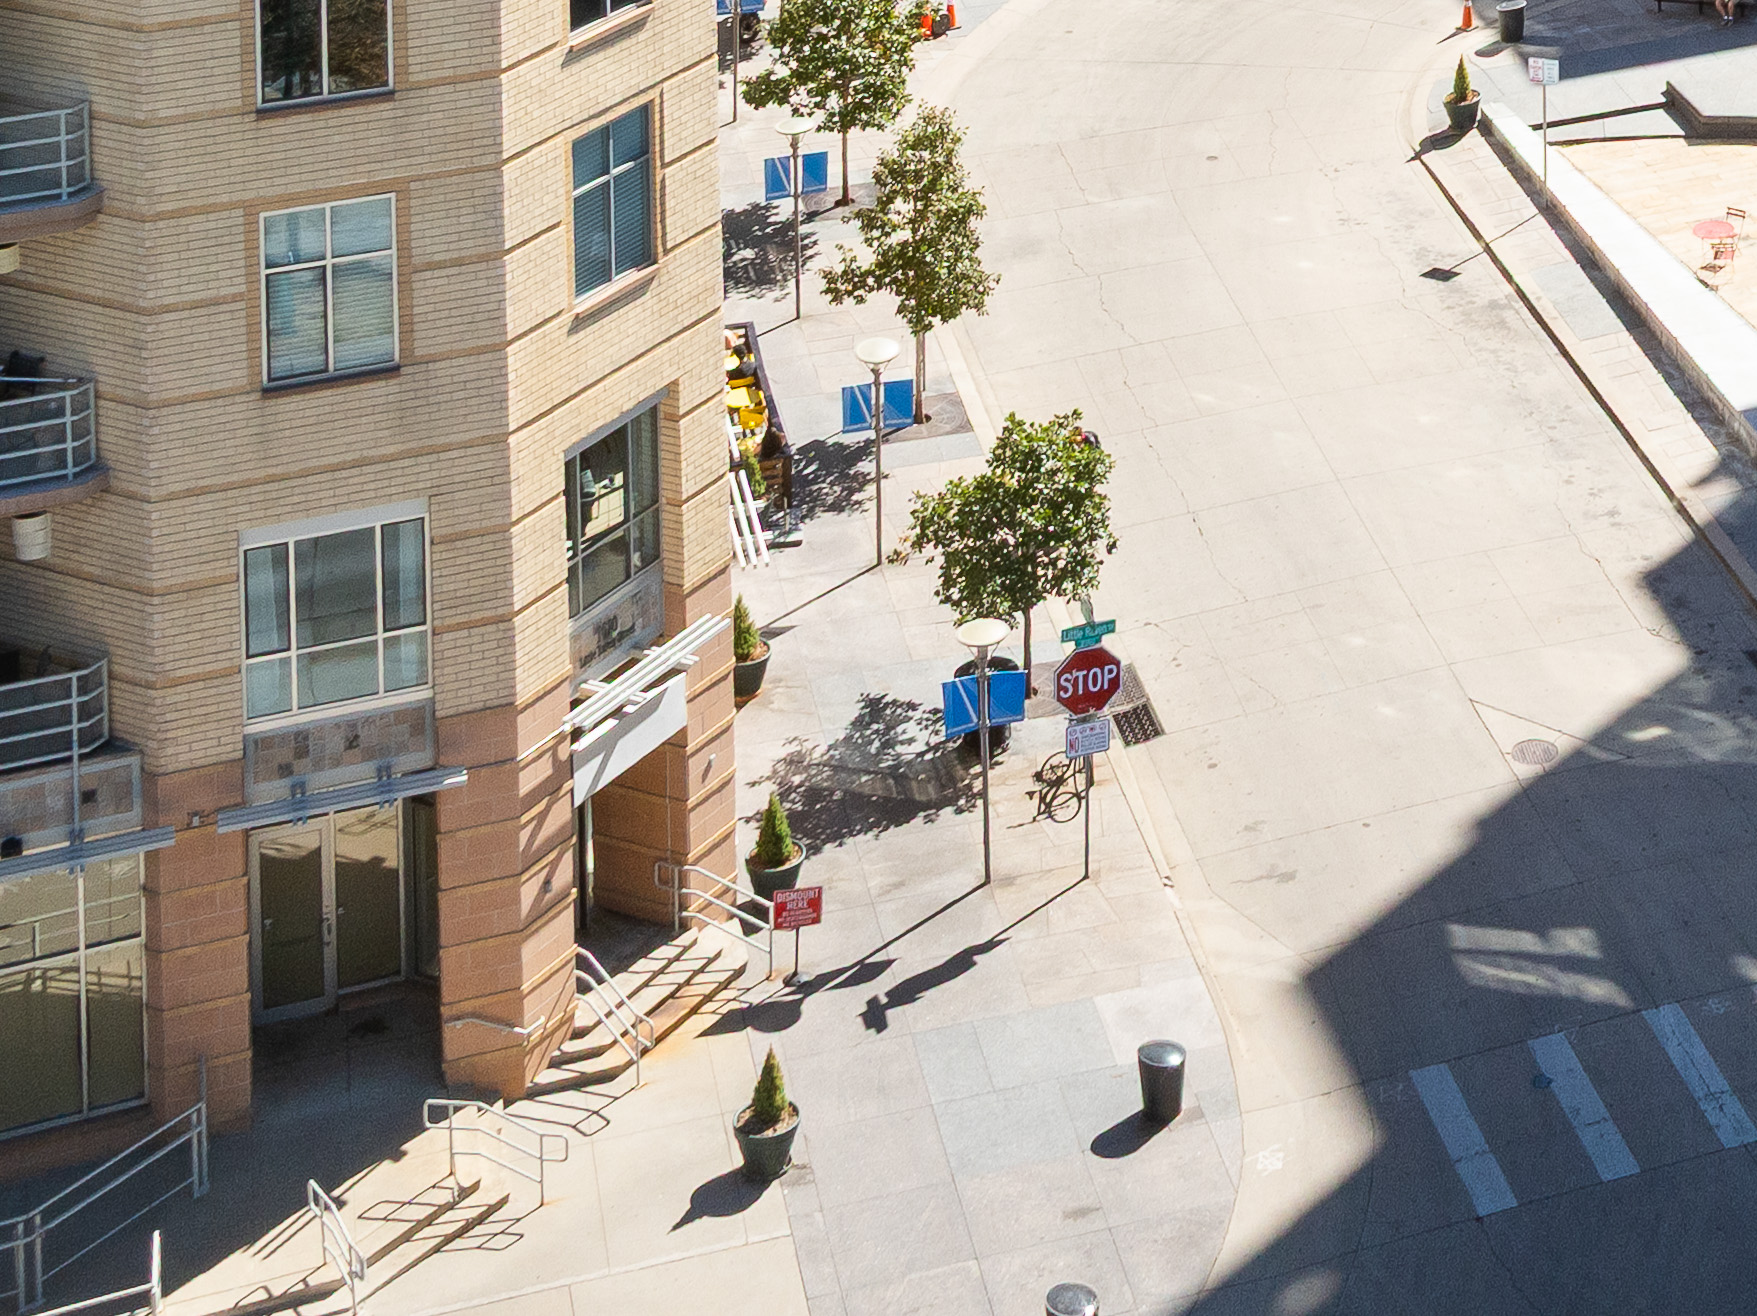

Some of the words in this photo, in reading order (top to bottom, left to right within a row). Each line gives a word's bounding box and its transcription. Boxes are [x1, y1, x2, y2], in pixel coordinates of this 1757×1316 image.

[1063, 628, 1084, 642] Little
[1085, 624, 1107, 637] Raven
[1059, 664, 1118, 699] STOP
[1069, 736, 1080, 754] NO
[777, 889, 819, 903] DISMOUNT
[787, 899, 809, 910] HERE
